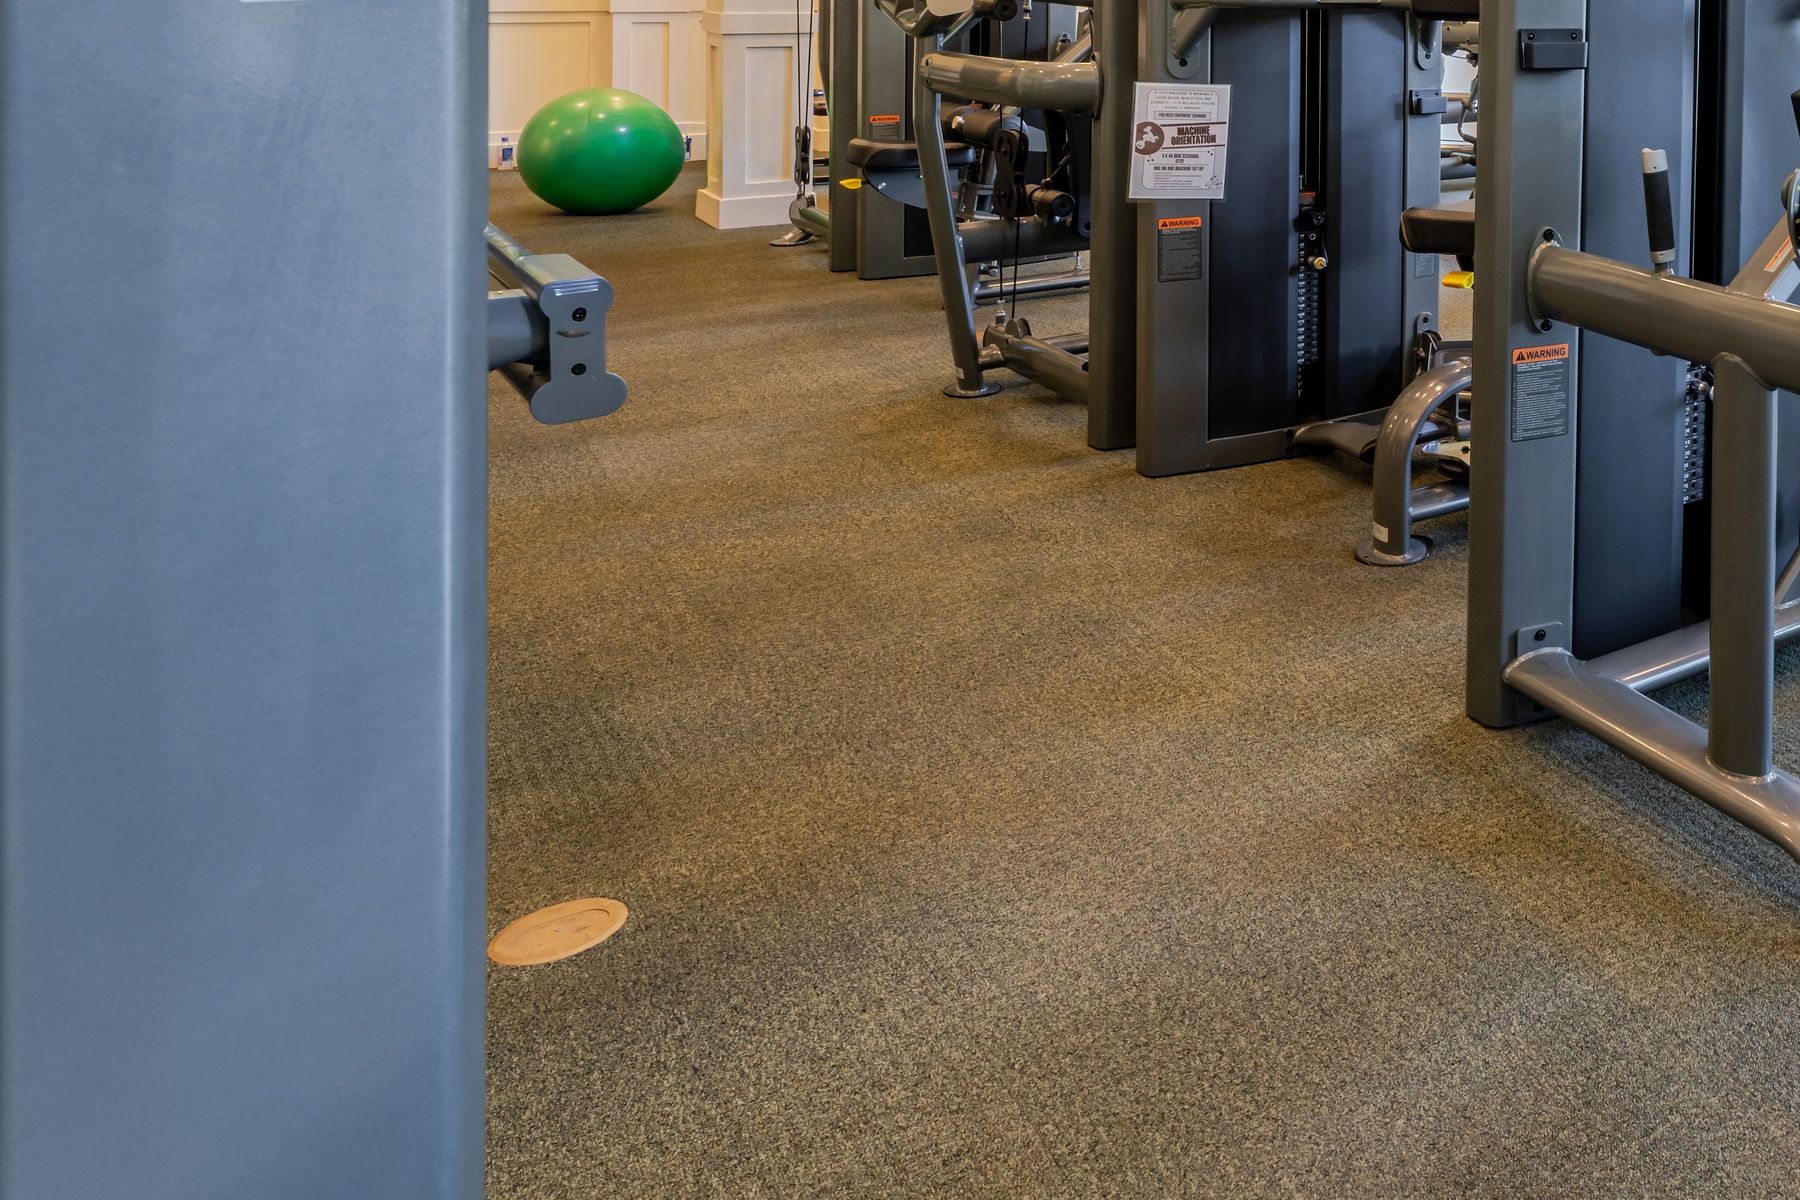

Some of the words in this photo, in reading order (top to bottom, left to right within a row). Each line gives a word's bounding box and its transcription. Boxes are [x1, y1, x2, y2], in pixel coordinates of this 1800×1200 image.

[1177, 126, 1210, 135] MACHINE
[1171, 135, 1216, 145] ORIENTATION
[1168, 219, 1199, 227] WARNING
[1526, 348, 1566, 360] WARNING
